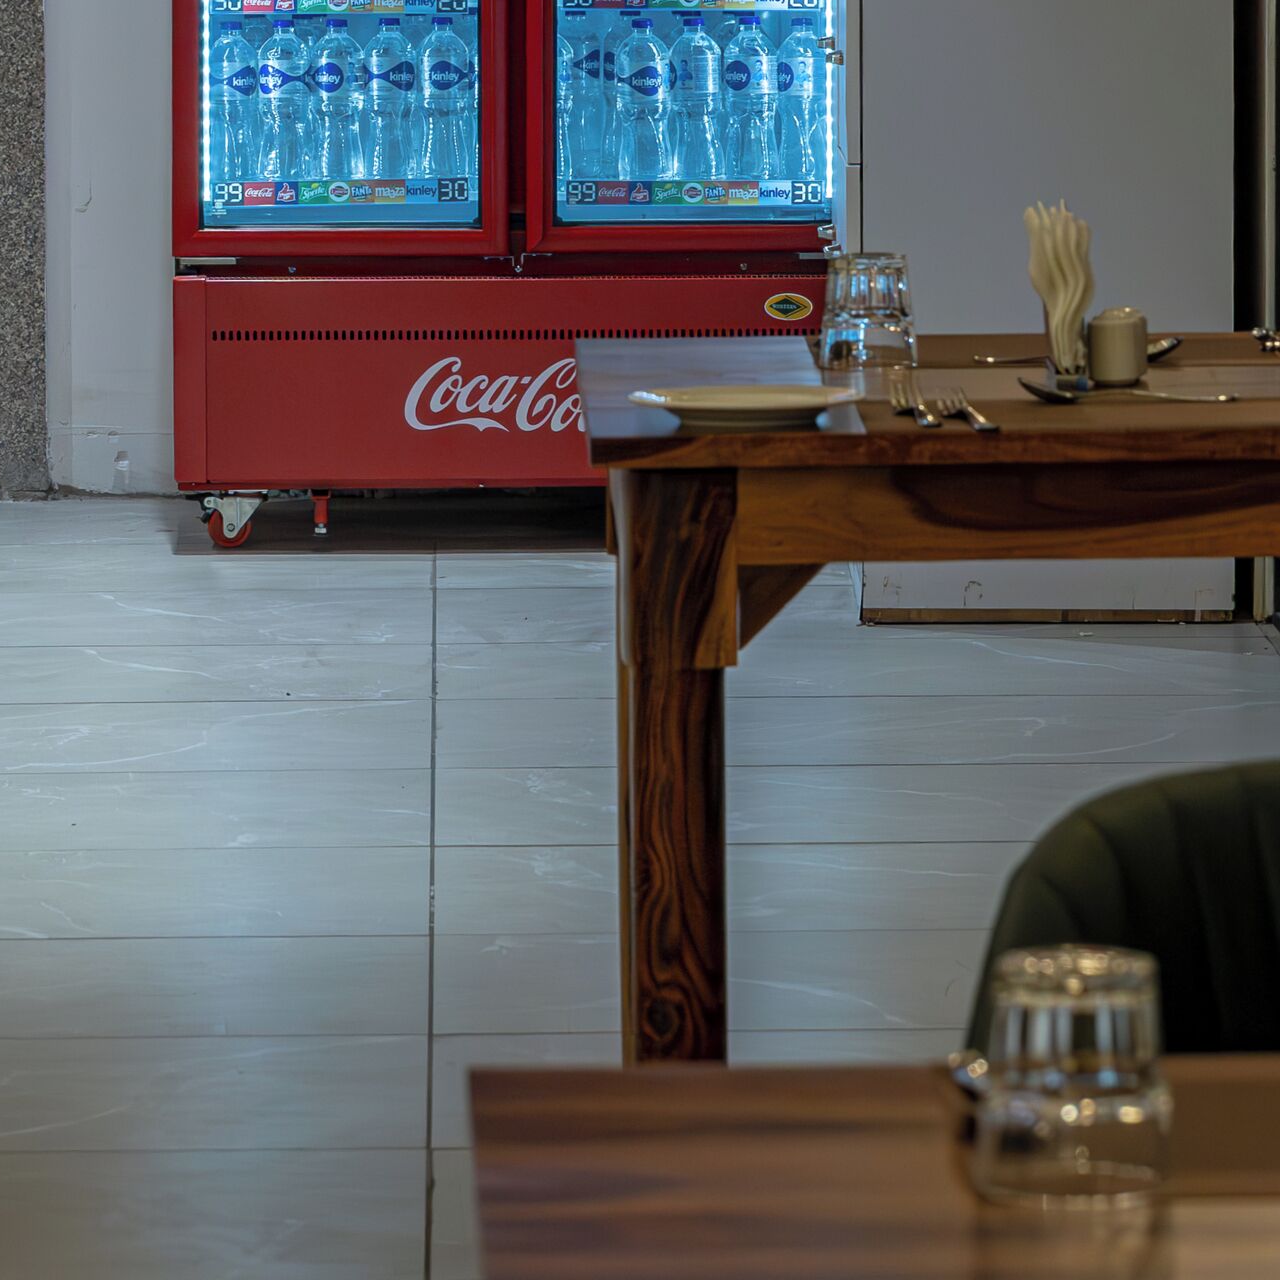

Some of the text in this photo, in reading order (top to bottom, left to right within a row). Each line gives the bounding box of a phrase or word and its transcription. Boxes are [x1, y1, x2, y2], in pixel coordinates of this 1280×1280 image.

[431, 71, 460, 82] kinley
[215, 183, 242, 203] 99
[406, 184, 437, 197] kinley
[440, 181, 467, 200] 30
[569, 182, 596, 202] 99
[759, 186, 790, 200] kinley
[793, 183, 821, 202] 30
